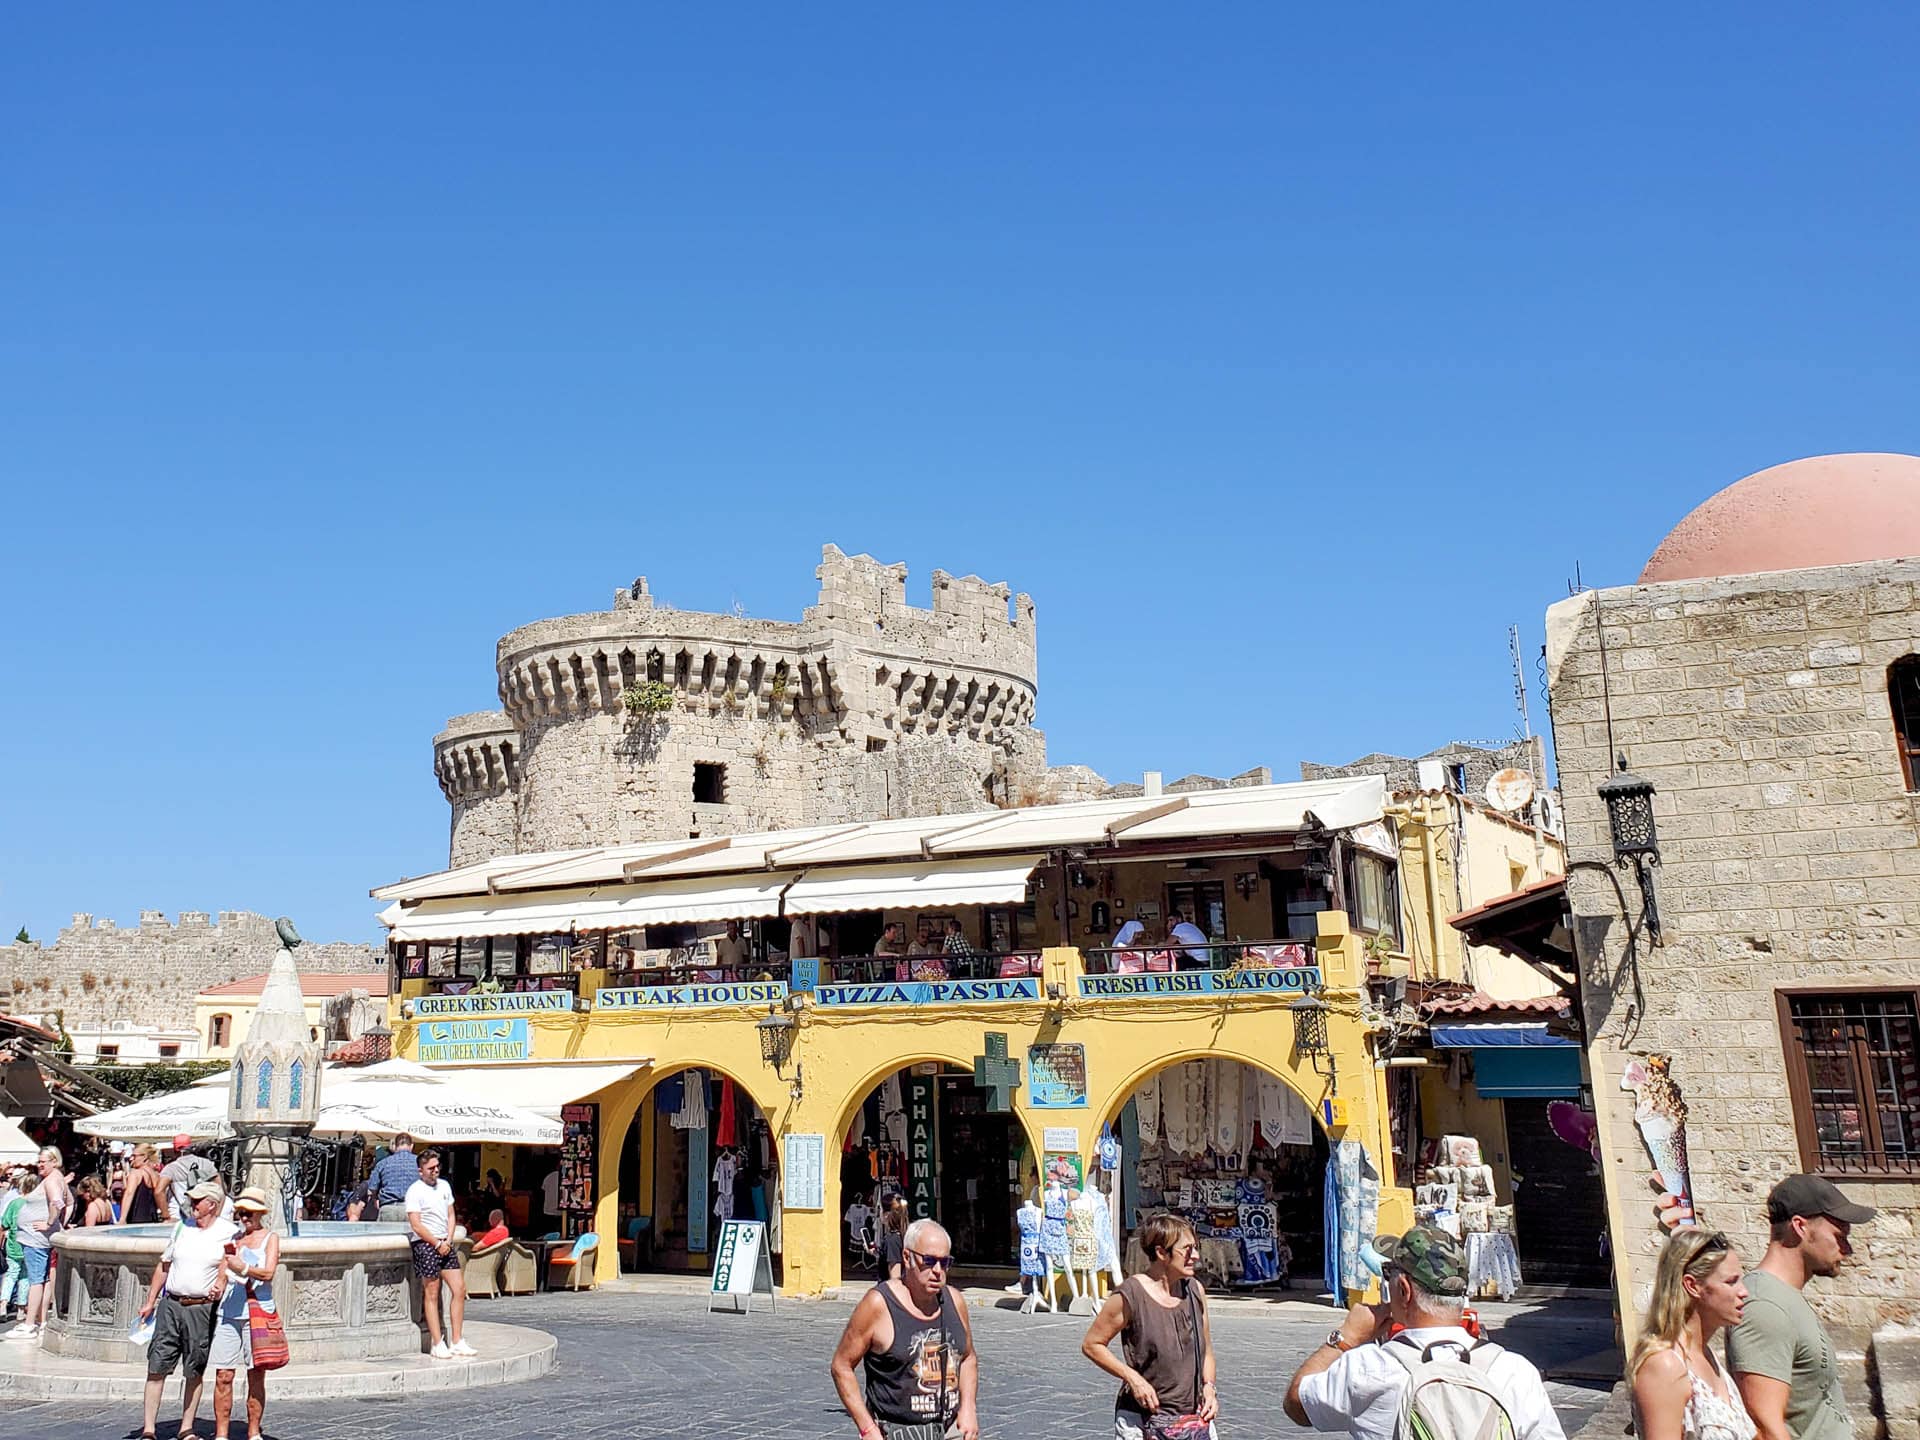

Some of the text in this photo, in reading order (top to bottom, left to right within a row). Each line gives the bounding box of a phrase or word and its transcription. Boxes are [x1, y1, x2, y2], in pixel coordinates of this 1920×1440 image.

[818, 981, 1033, 1004] PIZZA PASTA
[1081, 970, 1317, 994] FRESH FISH SEAFOOD
[420, 994, 566, 1013] GREEK RESTAURANT
[601, 983, 783, 1007] STEAK HOUSE
[452, 1024, 488, 1040] KOLONA
[420, 1042, 523, 1061] FAMILY GREEK RESTAURANT
[446, 1127, 480, 1135] DELICIOUS
[913, 1086, 929, 1217] PHARMAC
[716, 1224, 738, 1290] PHARMACY
[911, 1393, 936, 1412] BIG
